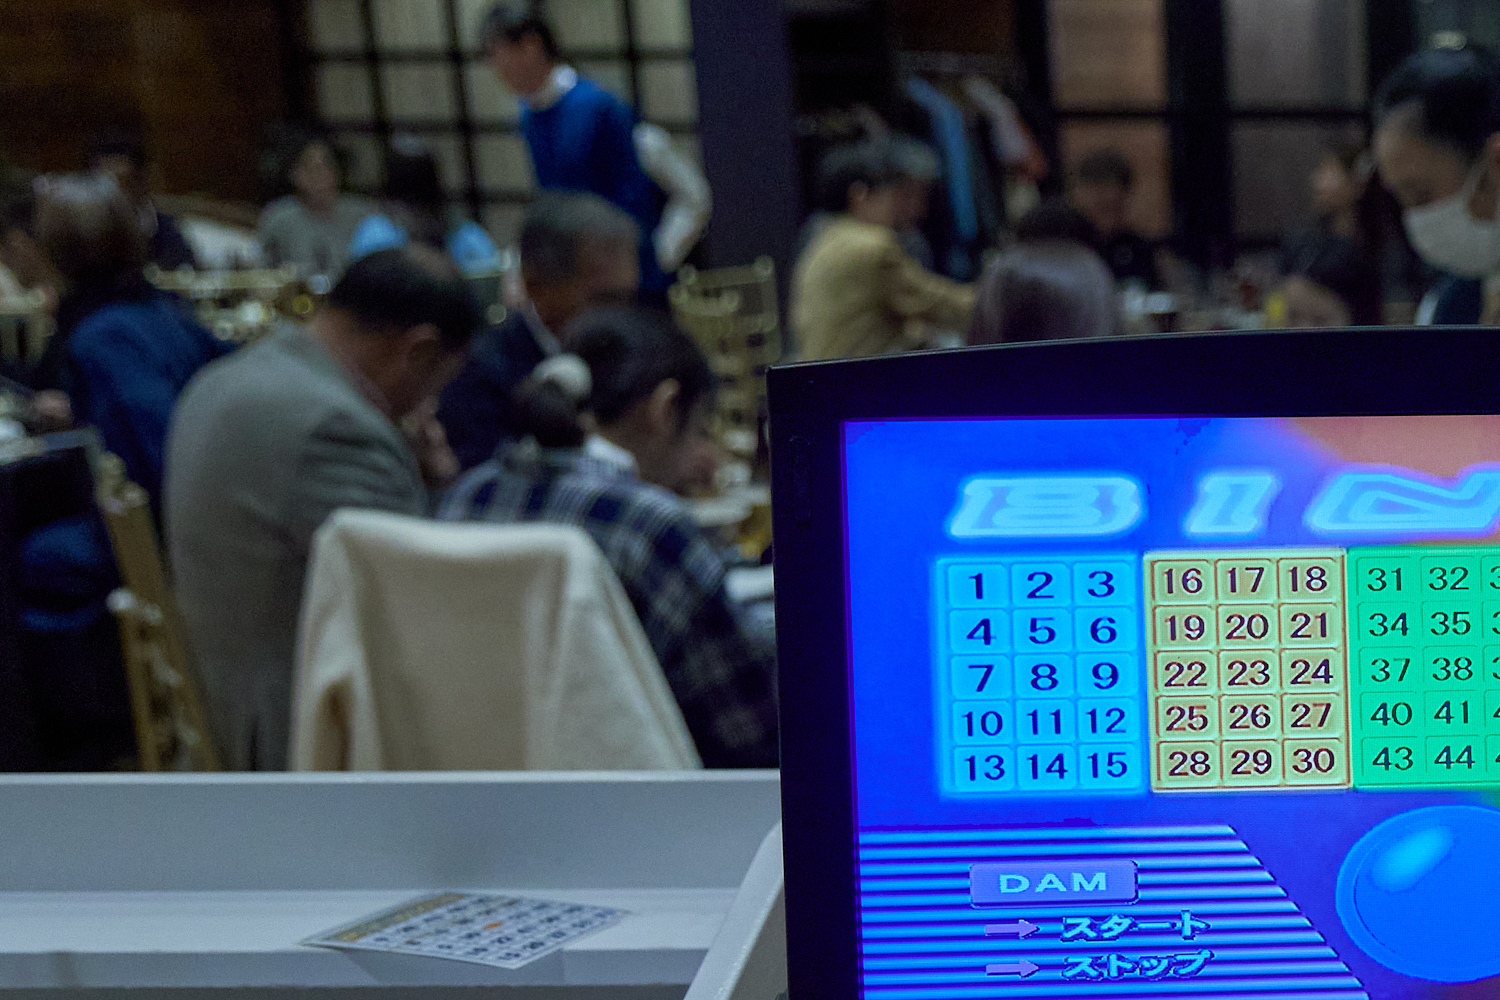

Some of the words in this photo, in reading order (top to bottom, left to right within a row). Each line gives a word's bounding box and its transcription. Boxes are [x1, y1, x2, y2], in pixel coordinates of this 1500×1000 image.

[969, 572, 984, 600] 1
[1026, 571, 1054, 599] 2
[1087, 570, 1115, 598] 3
[1164, 567, 1203, 595] 16
[1227, 566, 1265, 594] 17
[1289, 565, 1328, 593] 18
[1367, 567, 1402, 592] 31
[1428, 566, 1470, 591] 32
[966, 618, 994, 646] 4
[1028, 617, 1056, 645] 5
[1090, 617, 1117, 644] 6
[1165, 614, 1205, 642] 19
[1225, 613, 1269, 640] 20
[1290, 612, 1327, 639] 21
[1369, 612, 1409, 637] 34
[1430, 611, 1471, 636] 35
[968, 664, 994, 693] 7
[1030, 663, 1059, 691] 8
[1091, 662, 1119, 690] 9
[1164, 660, 1208, 688] 22
[1227, 659, 1271, 687] 23
[1290, 658, 1334, 685] 24
[1371, 658, 1411, 683] 37
[1432, 657, 1474, 681] 38
[962, 710, 1003, 737] 10
[1027, 708, 1061, 735] 11
[1086, 707, 1125, 734] 12
[1165, 705, 1209, 732] 25
[1229, 704, 1271, 730] 26
[1290, 702, 1332, 728] 27
[1370, 702, 1413, 726] 40
[1433, 700, 1469, 725] 41
[965, 754, 1005, 782] 13
[1027, 752, 1068, 780] 14
[1087, 751, 1128, 779] 15
[1168, 750, 1211, 777] 28
[1231, 749, 1272, 775] 29
[1292, 747, 1335, 774] 30
[1372, 746, 1414, 771] 43
[1434, 744, 1476, 770] 44
[999, 872, 1107, 894] DAM
[1062, 910, 1211, 940] スタート
[1062, 950, 1214, 980] ストップ
